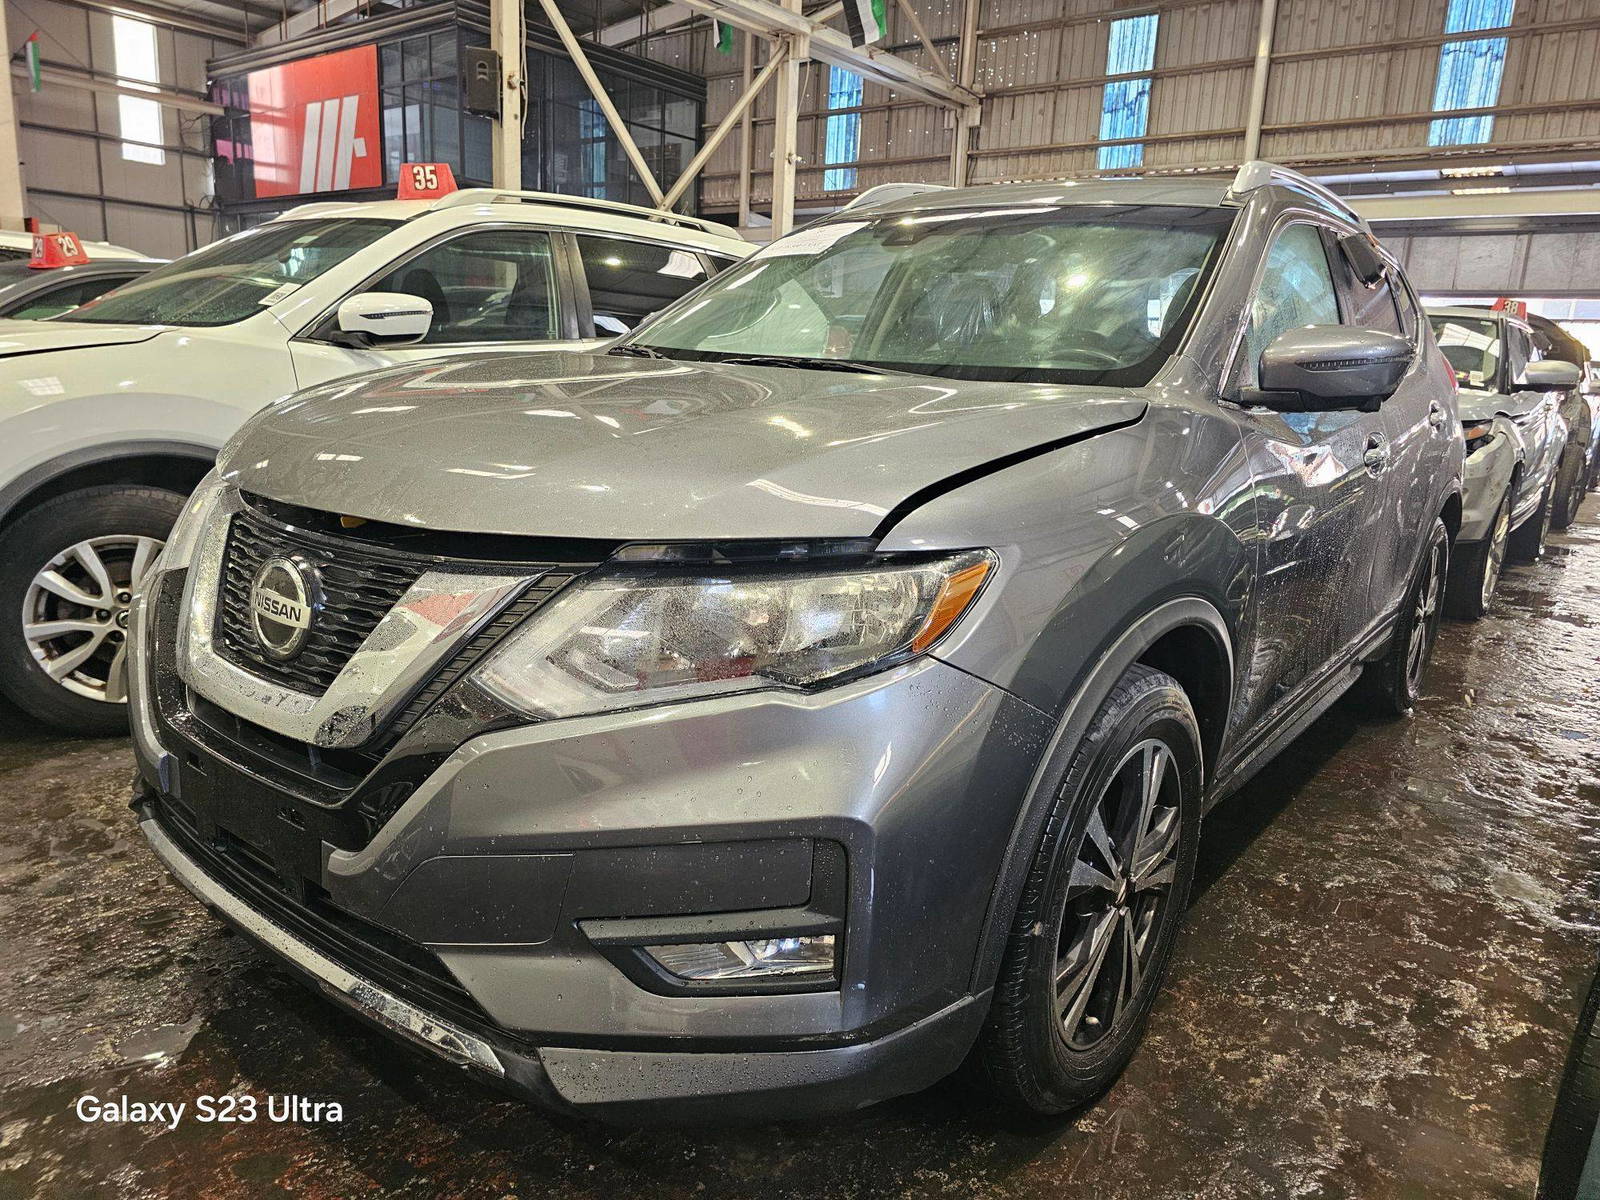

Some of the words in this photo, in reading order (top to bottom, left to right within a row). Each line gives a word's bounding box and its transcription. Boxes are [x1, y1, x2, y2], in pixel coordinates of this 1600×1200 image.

[412, 165, 438, 190] 35
[57, 235, 78, 257] 29
[1504, 301, 1518, 315] 38
[255, 590, 301, 622] NISSAN
